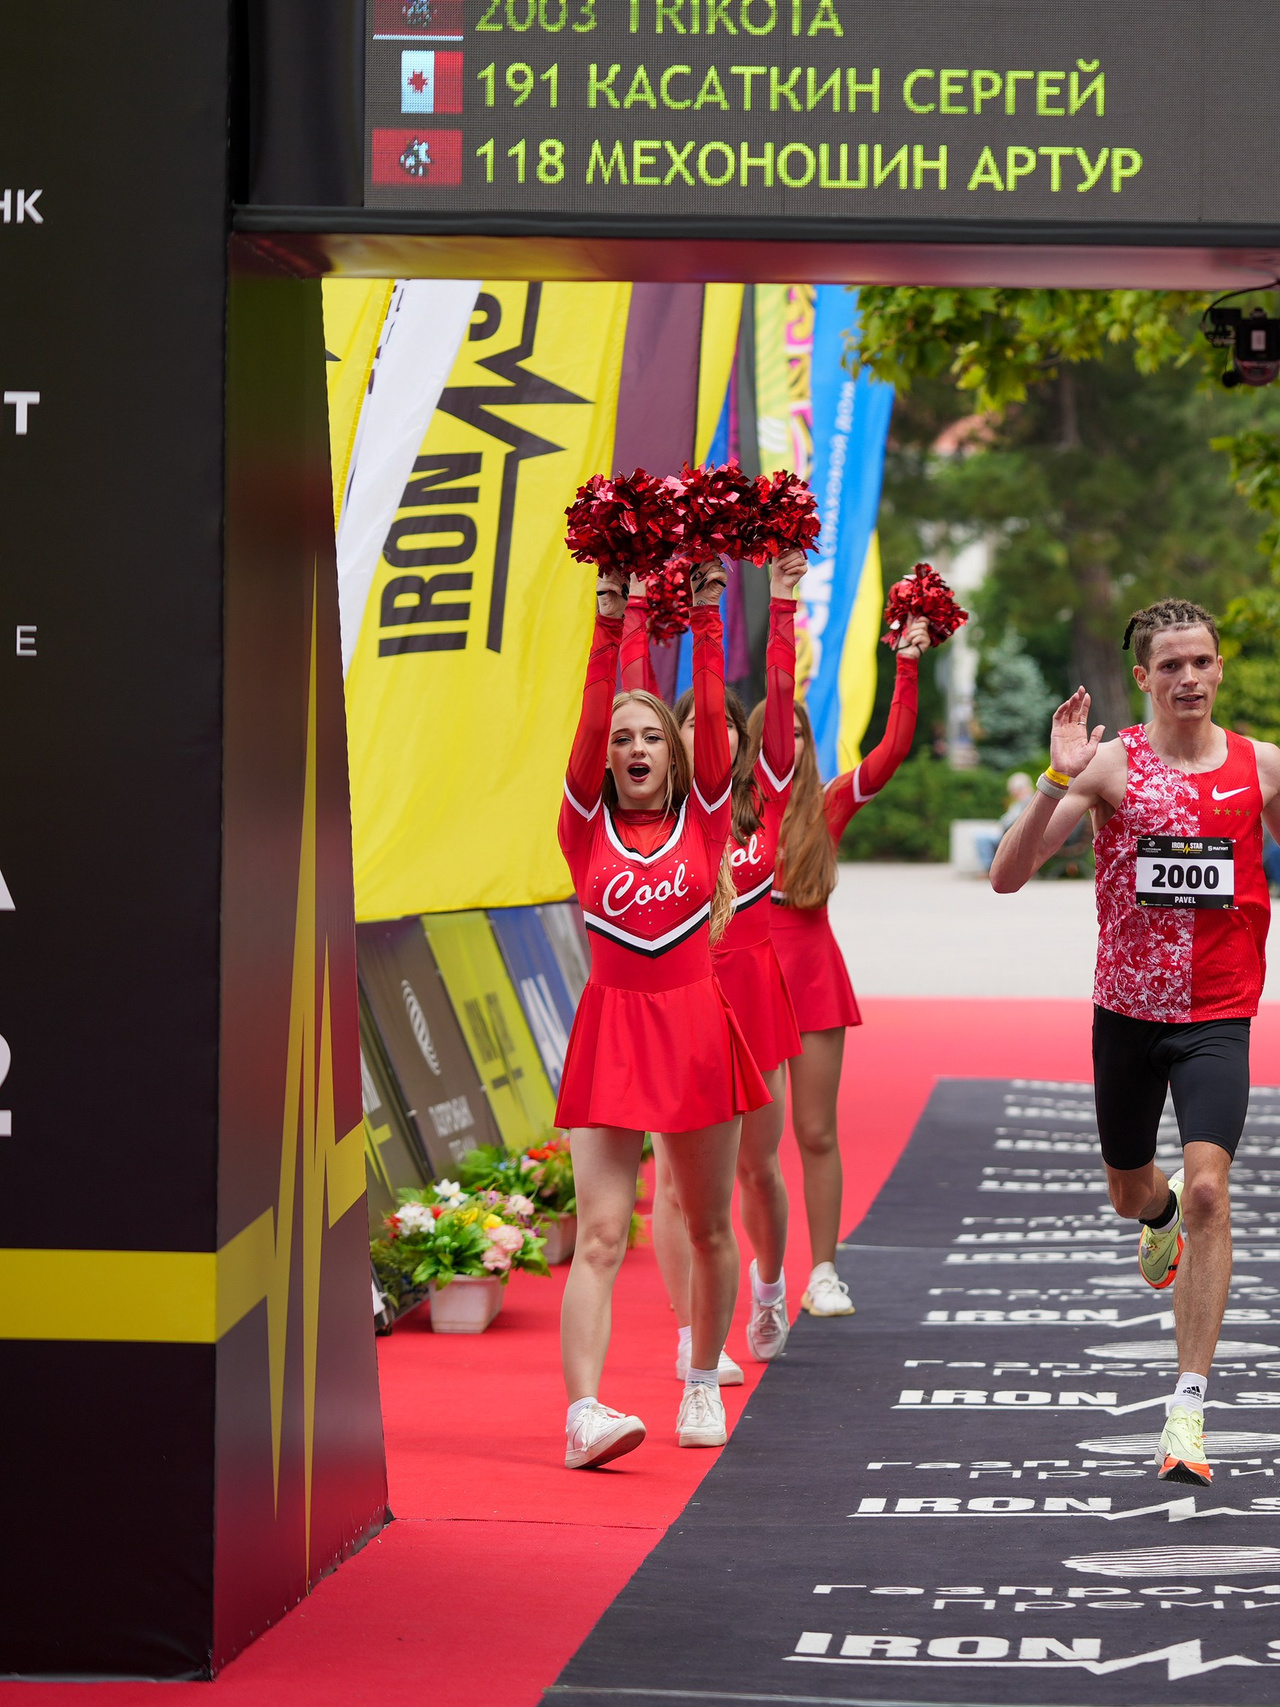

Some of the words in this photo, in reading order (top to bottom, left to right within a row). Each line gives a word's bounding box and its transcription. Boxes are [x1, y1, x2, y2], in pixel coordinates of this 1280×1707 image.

[475, 0, 598, 32] 2003
[628, 0, 845, 37] TRIKOTA
[475, 62, 563, 109] 191
[586, 63, 881, 113] КАСАТКИН
[902, 59, 1106, 117] СЕРГЕЙ
[475, 138, 566, 186] 118
[586, 139, 947, 191] МЕХОНОШИН
[967, 145, 1143, 193] АРТУР
[378, 452, 483, 658] IRON
[1190, 842, 1204, 850] STAR
[602, 862, 690, 917] Cool
[1151, 864, 1220, 890] 2000
[1174, 896, 1196, 904] PAVEL
[926, 1309, 1119, 1322] IRON
[898, 1390, 1118, 1405] IRON
[857, 1496, 1112, 1513] IRON
[794, 1631, 1104, 1661] IRON
